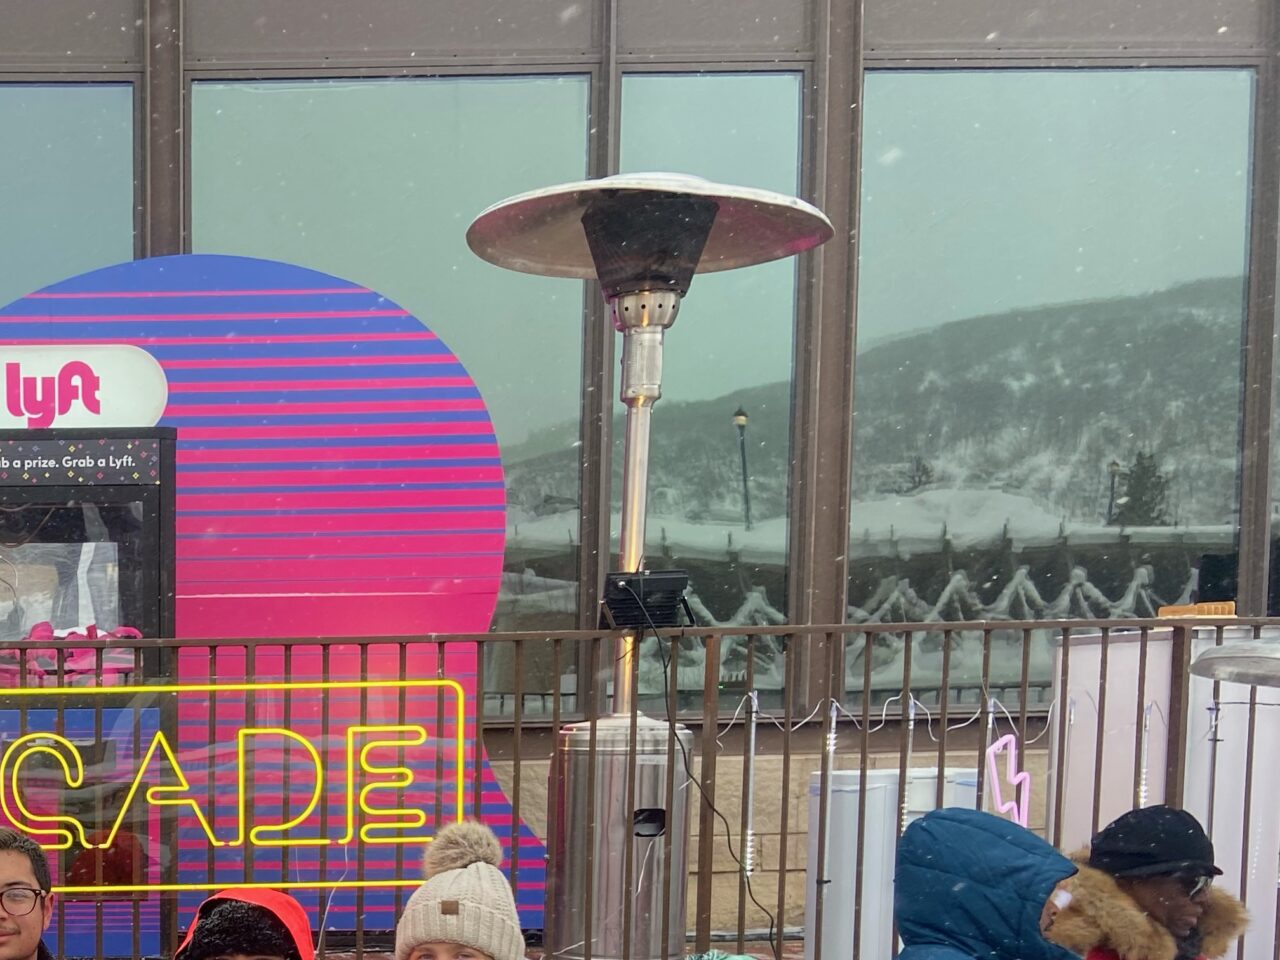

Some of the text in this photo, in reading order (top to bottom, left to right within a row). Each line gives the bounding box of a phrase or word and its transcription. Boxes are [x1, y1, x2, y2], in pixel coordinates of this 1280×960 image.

[5, 360, 101, 429] lyft
[12, 460, 21, 468] a
[24, 456, 59, 470] prize.
[62, 456, 95, 468] Grab
[97, 459, 106, 467] a
[109, 455, 136, 469] Lyft.
